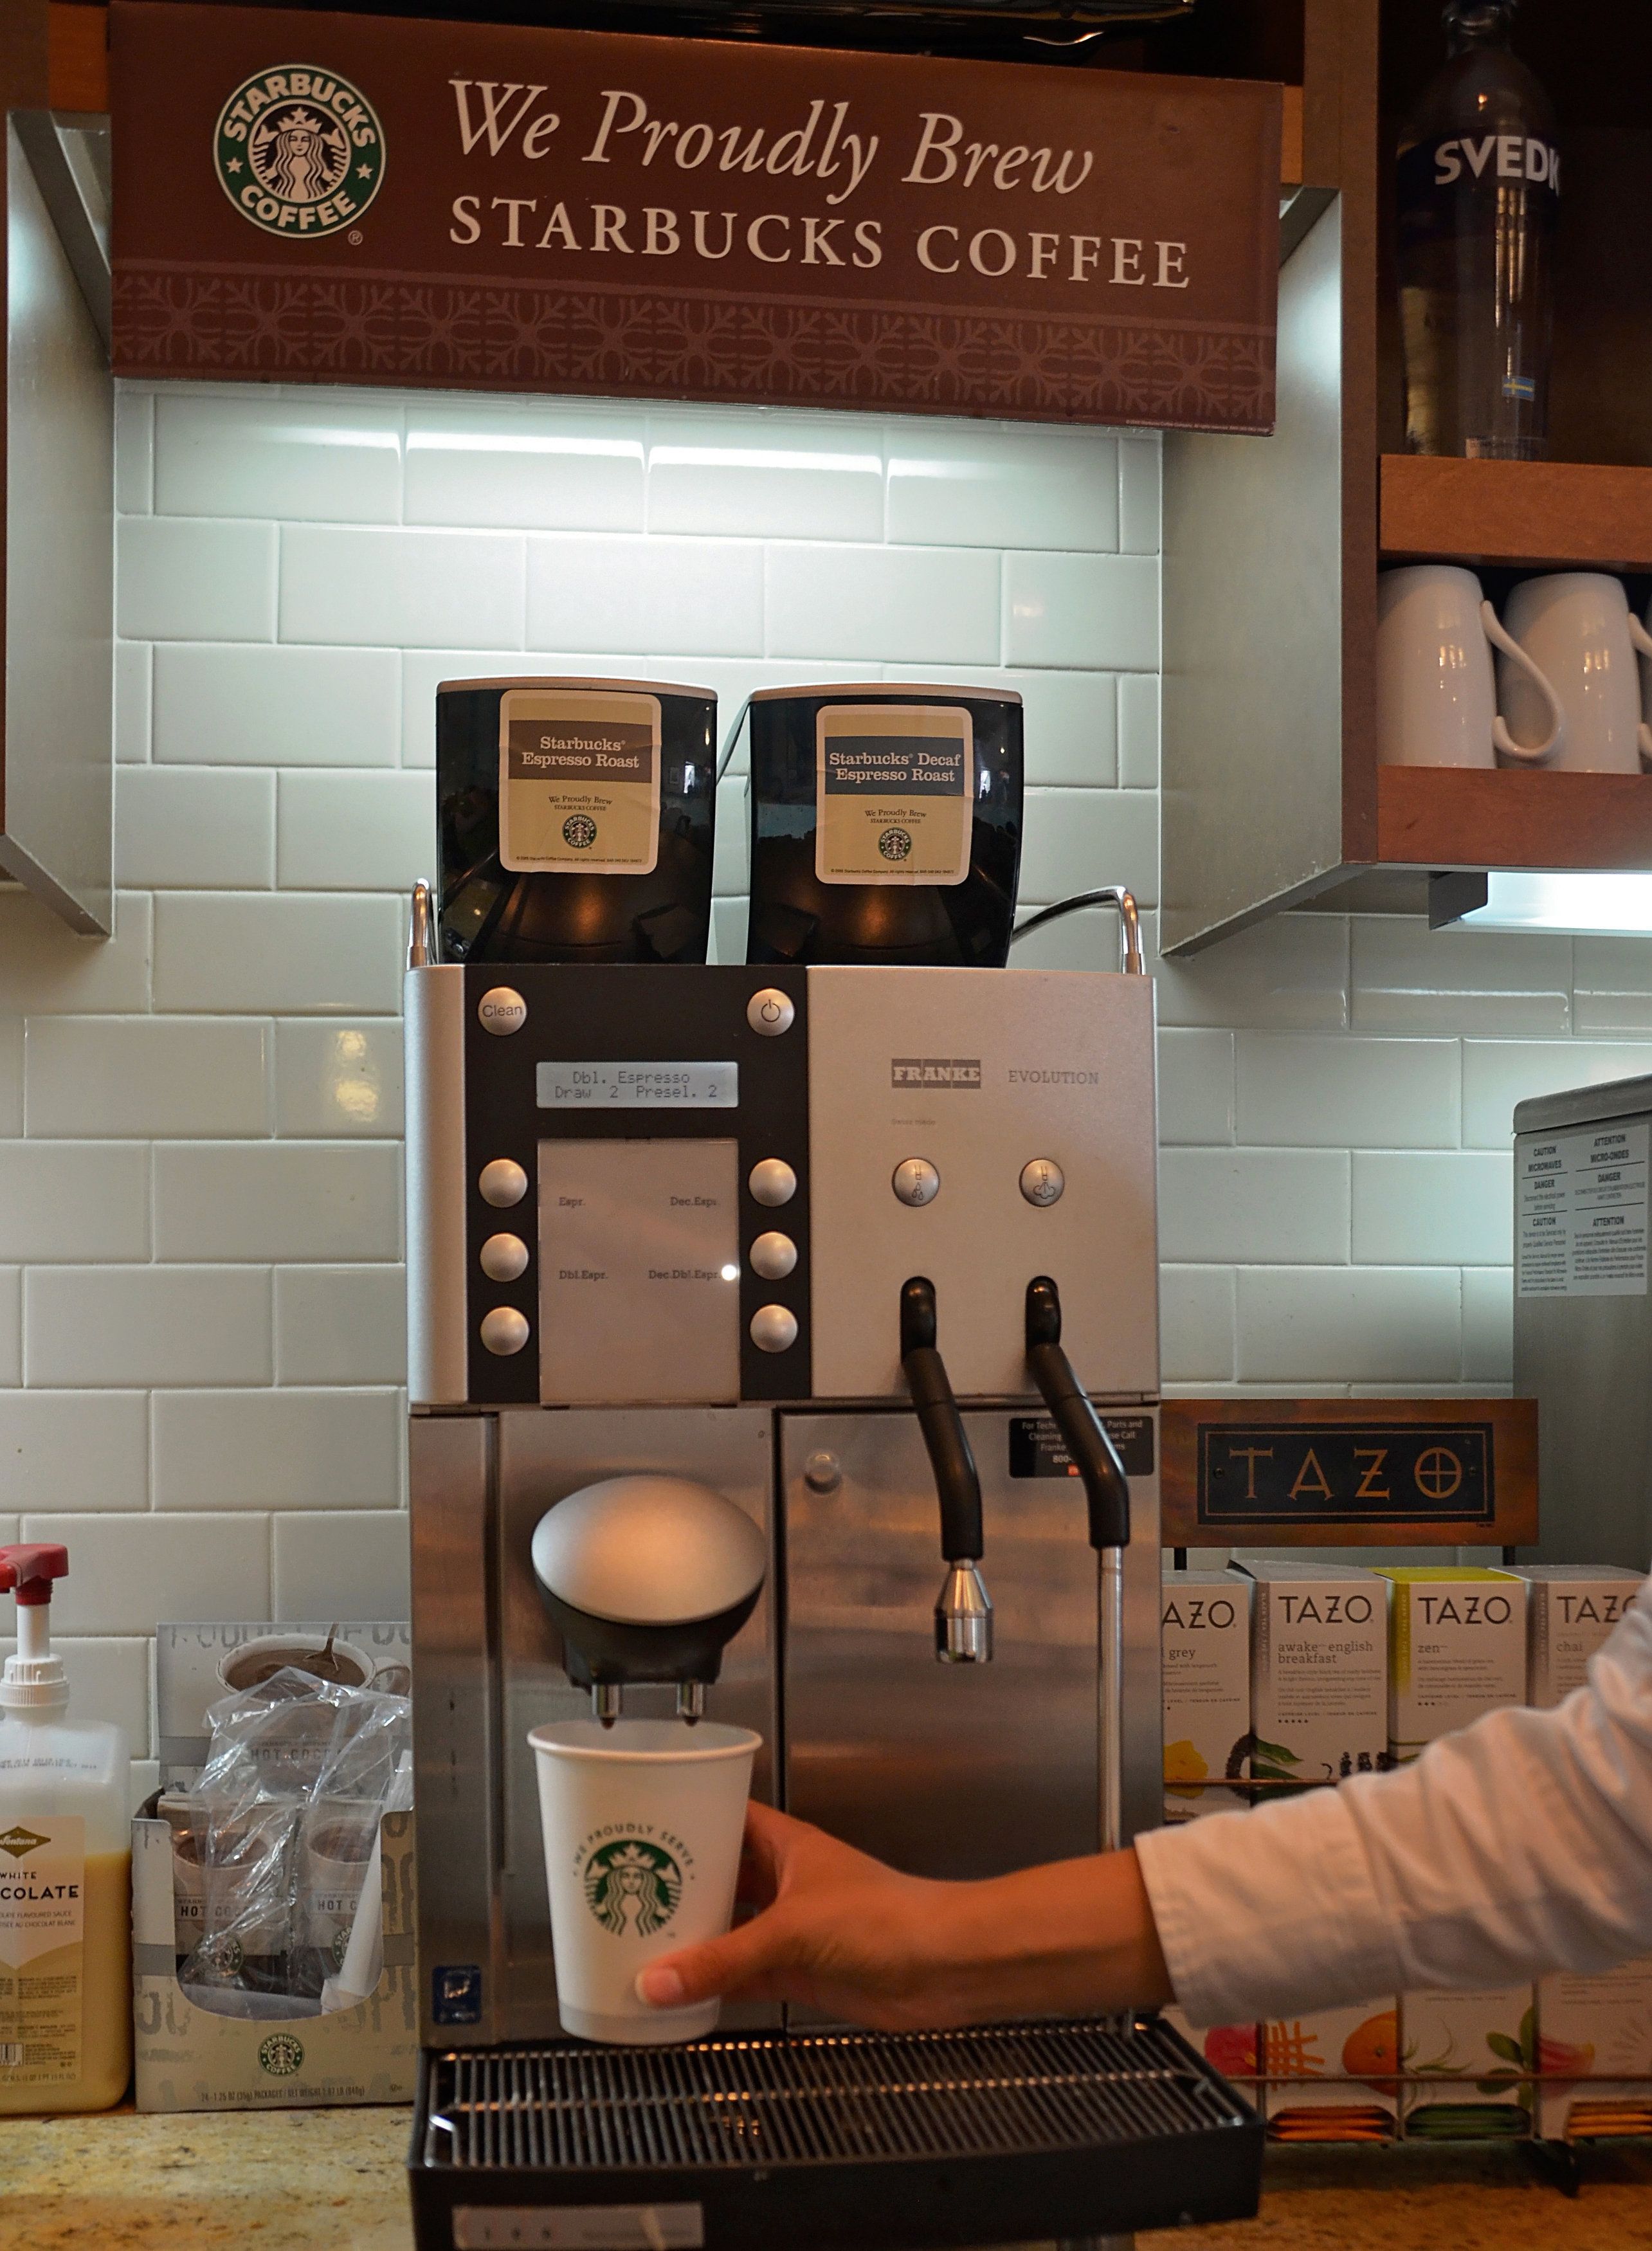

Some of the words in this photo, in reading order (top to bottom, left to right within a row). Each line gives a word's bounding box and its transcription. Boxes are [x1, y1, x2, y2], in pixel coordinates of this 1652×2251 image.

[223, 73, 376, 149] STARBUCKS
[449, 79, 560, 159] We
[582, 91, 879, 205] Proudly
[902, 113, 1093, 194] Brew
[240, 185, 357, 230] COFFEE
[450, 195, 882, 268] STARBUCKS
[916, 225, 1189, 288] COFFEE
[522, 752, 592, 769] Espresso
[595, 754, 639, 768] Roast
[918, 753, 961, 767] Decaf
[836, 769, 907, 783] Espresso
[911, 769, 955, 782] Roast
[562, 796, 592, 804] Proudly
[594, 796, 613, 805] Brew
[878, 809, 907, 817] Proudly
[565, 816, 595, 831] STARBUCKS
[568, 837, 590, 847] COFFEE
[881, 829, 910, 843] STARBUCKS
[883, 851, 905, 860] COFFEE
[482, 1004, 522, 1017] Clean
[573, 1071, 606, 1084] Dbl.
[618, 1072, 690, 1084] Espresso
[893, 1066, 981, 1082] FRANKE
[1008, 1070, 1100, 1085] EVOLUTION
[555, 1086, 592, 1098] Draw
[610, 1086, 619, 1098] 2
[636, 1086, 696, 1098] Presel.
[708, 1085, 717, 1097] 2
[1593, 1134, 1626, 1147] ATTENTION
[1533, 1145, 1556, 1157] CAUTION
[1590, 1149, 1629, 1163] MICRO-ONDES
[1528, 1160, 1562, 1172] MICROWAVES
[1598, 1172, 1620, 1183] DANGER
[1534, 1180, 1555, 1190] DANGER
[1532, 1217, 1556, 1226] CAUTION
[1592, 1216, 1624, 1227] ATTENTION
[1107, 1420, 1127, 1428] Parts
[1128, 1419, 1143, 1428] and
[1029, 1433, 1061, 1442] Cleaning
[1228, 1446, 1462, 1500] TAZO
[1278, 1595, 1372, 1624] TAZO
[1417, 1596, 1511, 1625] TAZO
[1278, 1641, 1318, 1652] awake
[1328, 1641, 1374, 1655] english
[1417, 1645, 1440, 1654] zen
[1556, 1641, 1583, 1652] chai
[1168, 1649, 1196, 1661] grey
[1278, 1654, 1337, 1664] breakfast
[251, 1749, 280, 1761] HOT
[588, 1823, 653, 1843] PROUDLY
[0, 1872, 37, 1880] WHITE
[0, 1885, 79, 1900] COLATE
[318, 1900, 342, 1910] HOT
[261, 2036, 301, 2054] STARBUCKS
[266, 2064, 296, 2075] COFFEE
